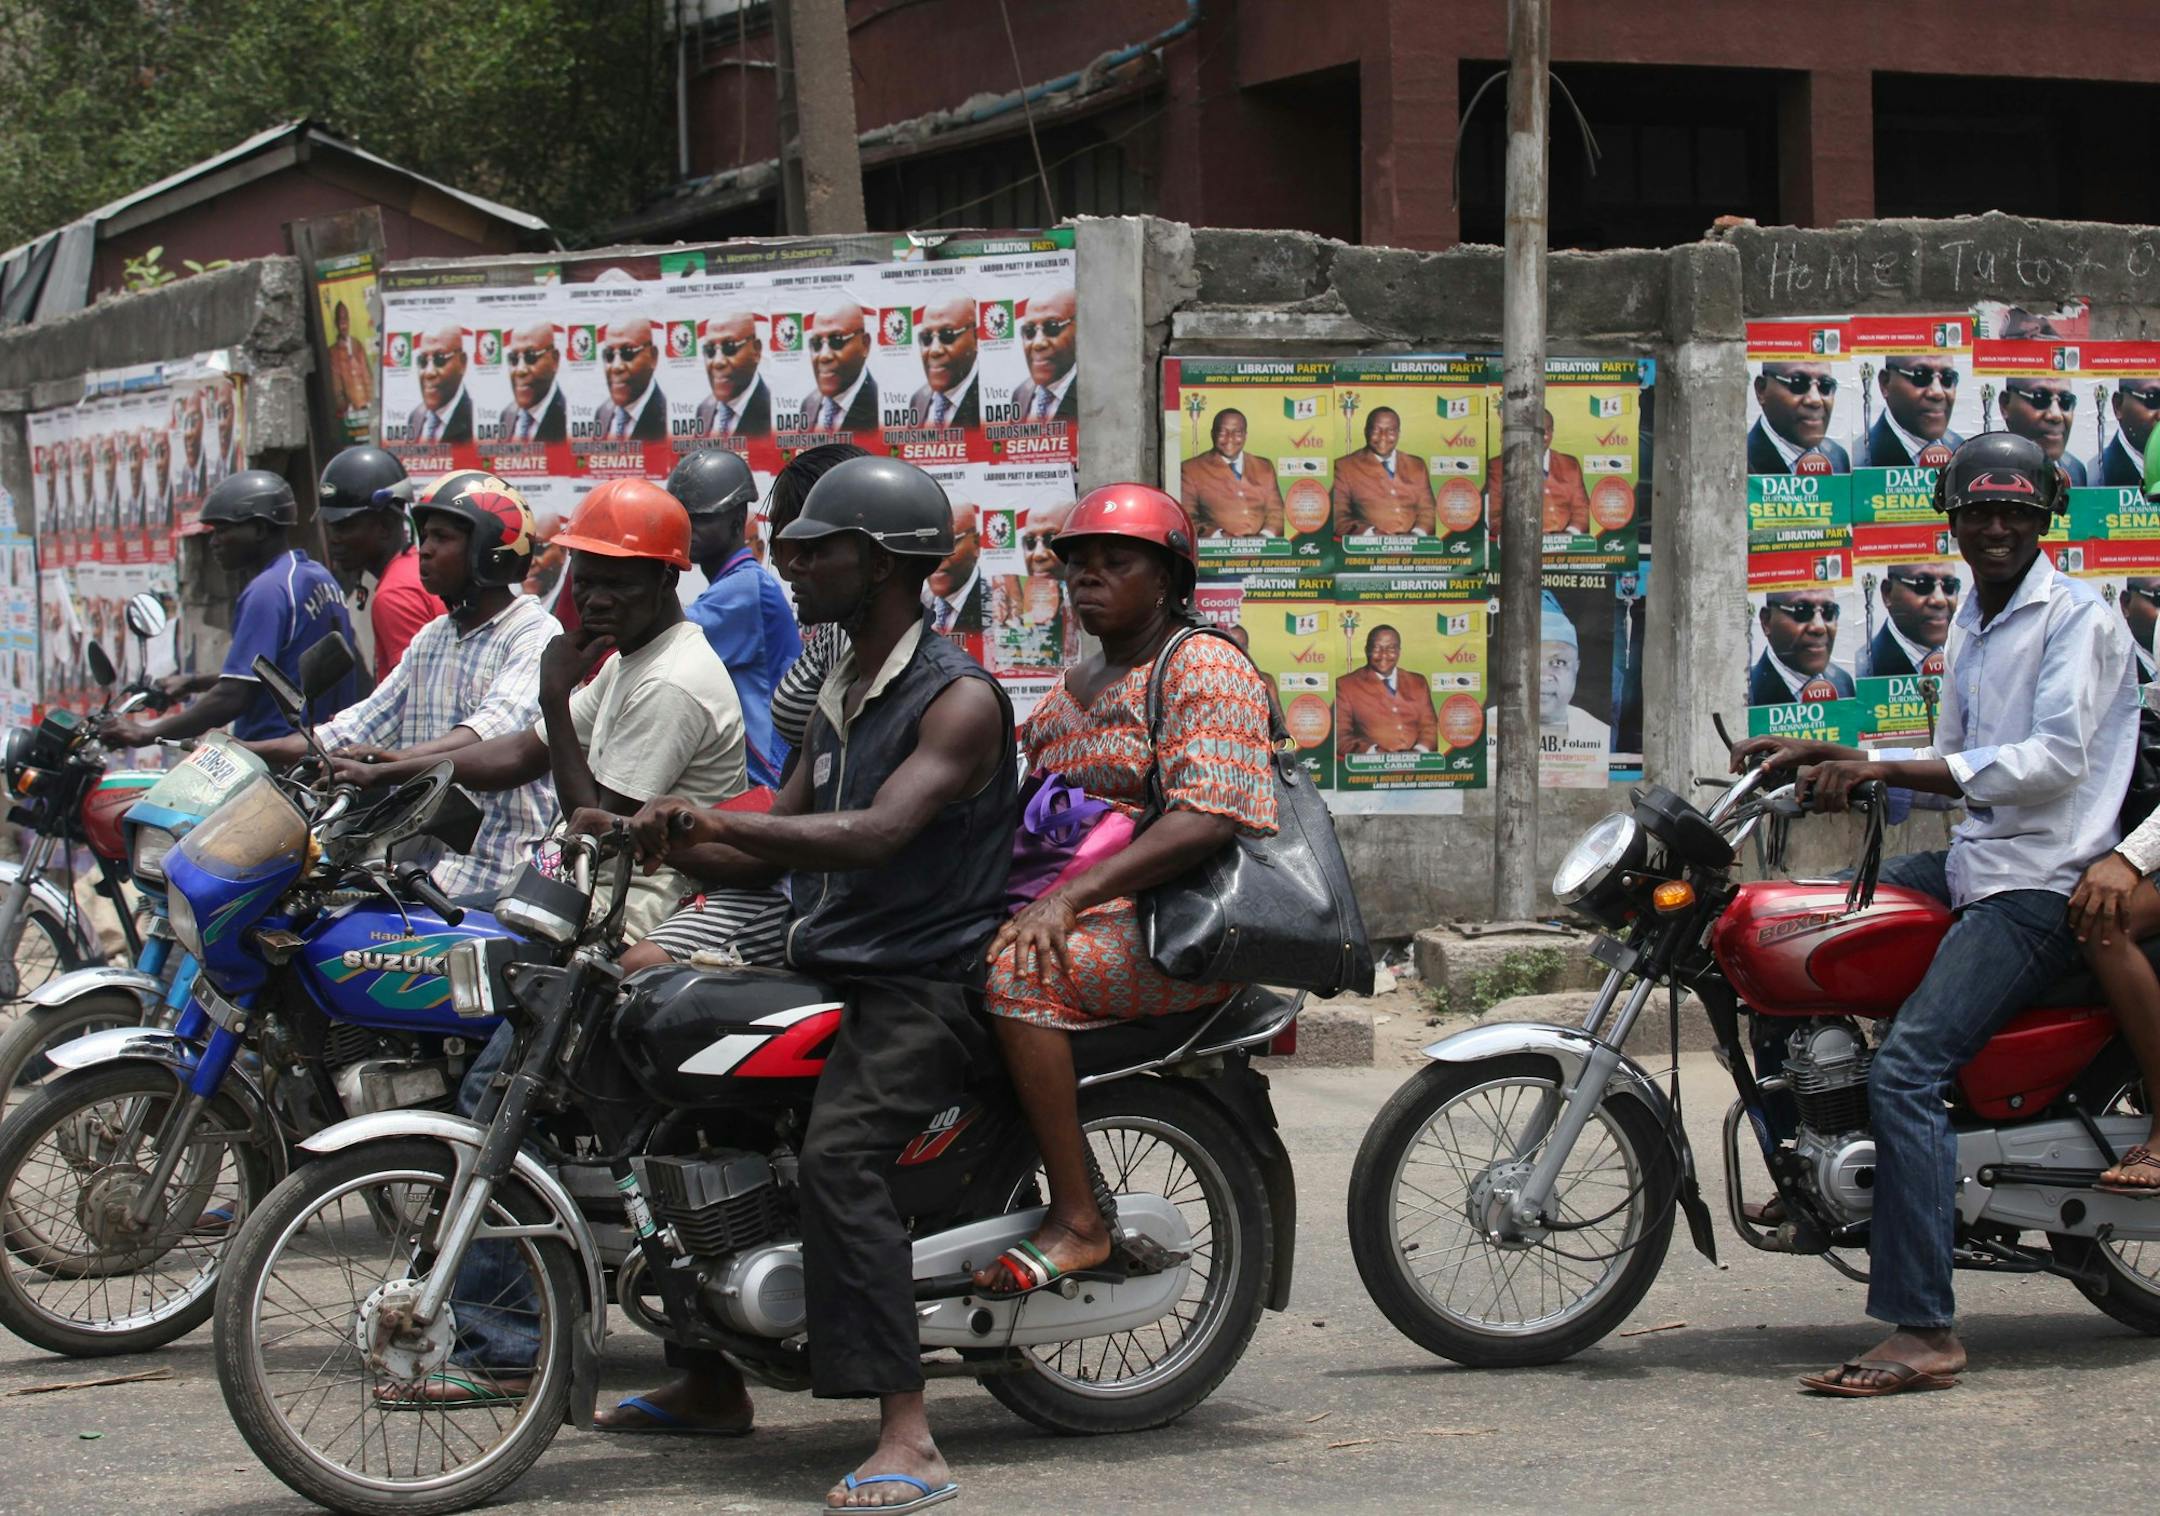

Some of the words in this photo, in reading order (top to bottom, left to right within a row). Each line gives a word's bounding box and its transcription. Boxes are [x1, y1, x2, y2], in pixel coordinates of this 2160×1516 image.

[984, 241, 1030, 253] LIBRATION
[1032, 240, 1056, 250] PARTY
[766, 251, 777, 261] of
[781, 248, 833, 259] Substance
[980, 263, 1004, 273] LABOUR
[1005, 262, 1025, 271] PARTY
[1026, 261, 1033, 270] OF
[1034, 259, 1058, 269] NIGERIA
[1059, 258, 1070, 267] (LP)
[1237, 363, 1294, 374] LIBRATION
[1296, 363, 1331, 373] PARTY
[1391, 362, 1448, 373] LIBRATION
[1450, 362, 1483, 373] PARTY
[1545, 362, 1600, 372] LIBRATION
[1602, 362, 1636, 372] PARTY
[883, 391, 908, 404] Vote
[984, 387, 1009, 400] Vote
[884, 408, 918, 427] DAPO
[985, 403, 1021, 423] DAPO
[572, 421, 603, 438] DAPO
[672, 418, 704, 436] DAPO
[776, 413, 808, 432] DAPO
[386, 425, 415, 441] DAPO
[478, 423, 507, 440] DAPO
[903, 443, 967, 459] SENATE
[1006, 436, 1070, 454] SENATE
[403, 457, 454, 470] SENATE
[494, 456, 548, 470] SENATE
[589, 454, 645, 469] SENATE
[1802, 462, 1826, 472] VOTE
[1886, 468, 1940, 487] DAPO
[1761, 477, 1818, 495] DAPO
[1749, 501, 1833, 517] SENATE
[1871, 494, 1935, 509] SENA
[2105, 513, 2160, 528] SENA
[1776, 529, 1824, 541] LIBRATION
[1298, 578, 1333, 590] PARTY
[1390, 580, 1447, 591] LIBRATION
[1449, 580, 1483, 590] PARTY
[1541, 574, 1578, 588] CHOICE
[1579, 575, 1607, 588] 2011
[1201, 598, 1242, 608] Goodlu
[1808, 688, 1831, 699] VOTE
[1888, 676, 1943, 696] DAO
[1768, 703, 1824, 726] DAPO
[1874, 703, 1940, 719] SENAT
[1771, 727, 1841, 742] NATE
